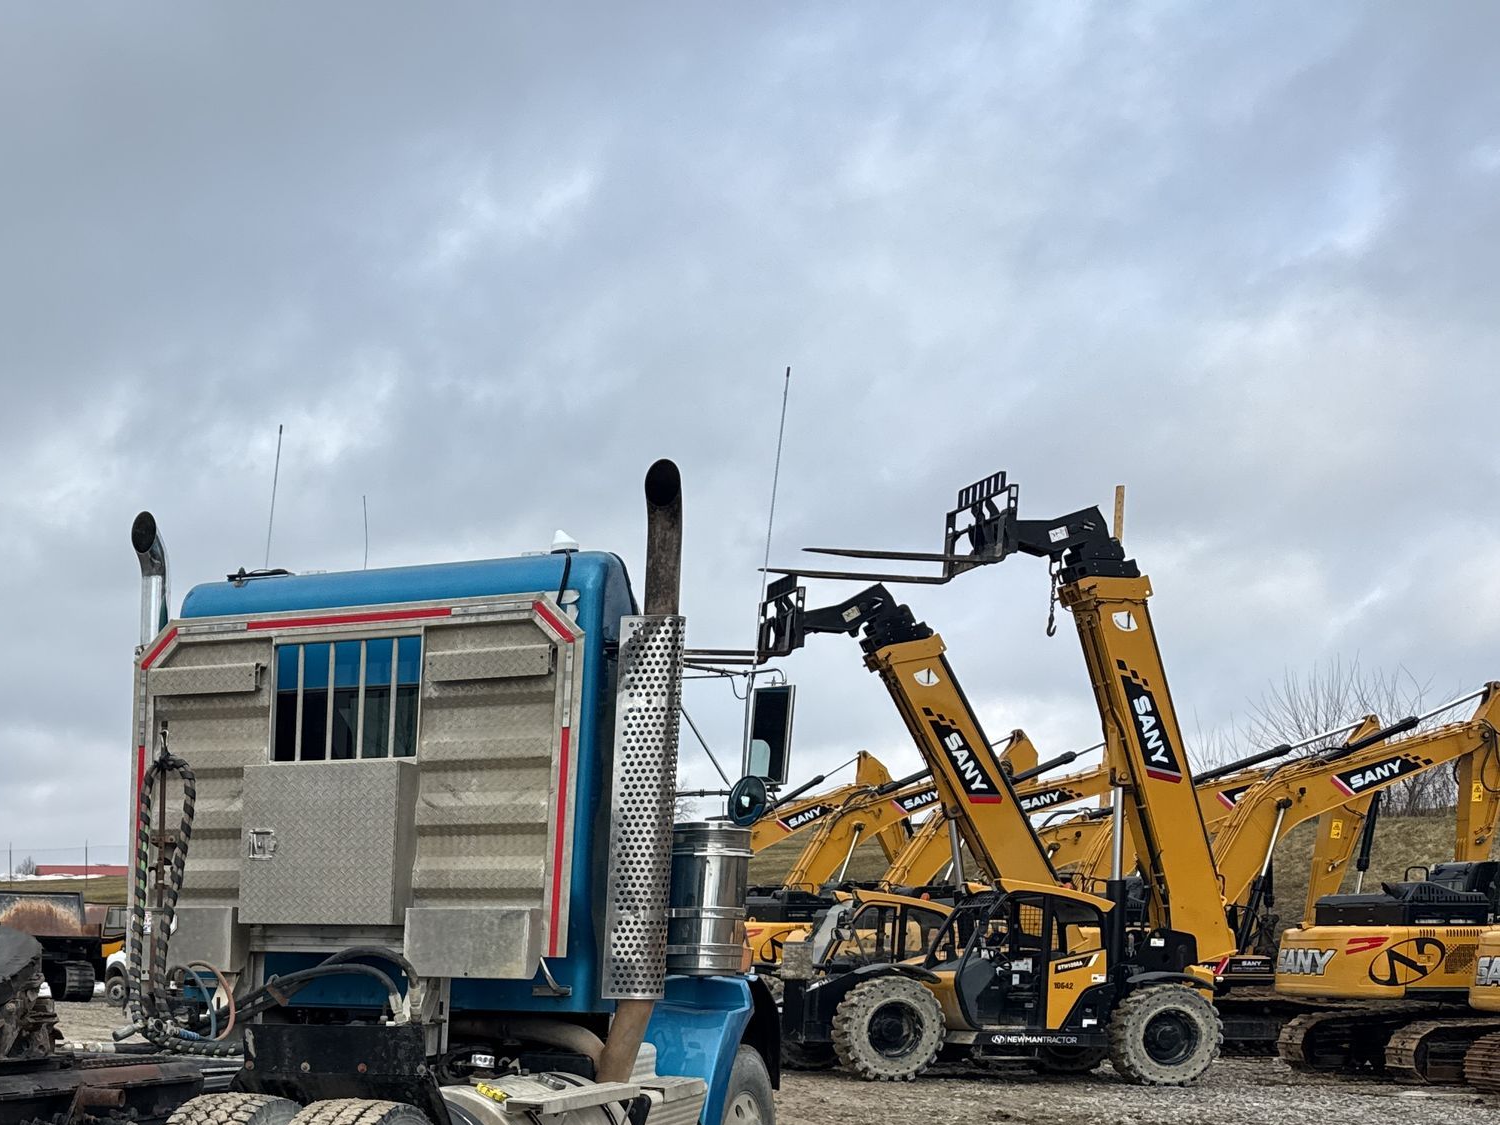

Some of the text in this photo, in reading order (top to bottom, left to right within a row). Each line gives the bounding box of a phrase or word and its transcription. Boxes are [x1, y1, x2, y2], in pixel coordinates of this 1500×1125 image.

[1132, 695, 1170, 764] SANY
[944, 732, 989, 791] SANY
[1349, 758, 1402, 790] SANY
[1020, 790, 1060, 811] SANY
[788, 806, 821, 828] SANY
[1007, 1035, 1078, 1044] NEWMANTRACTOR
